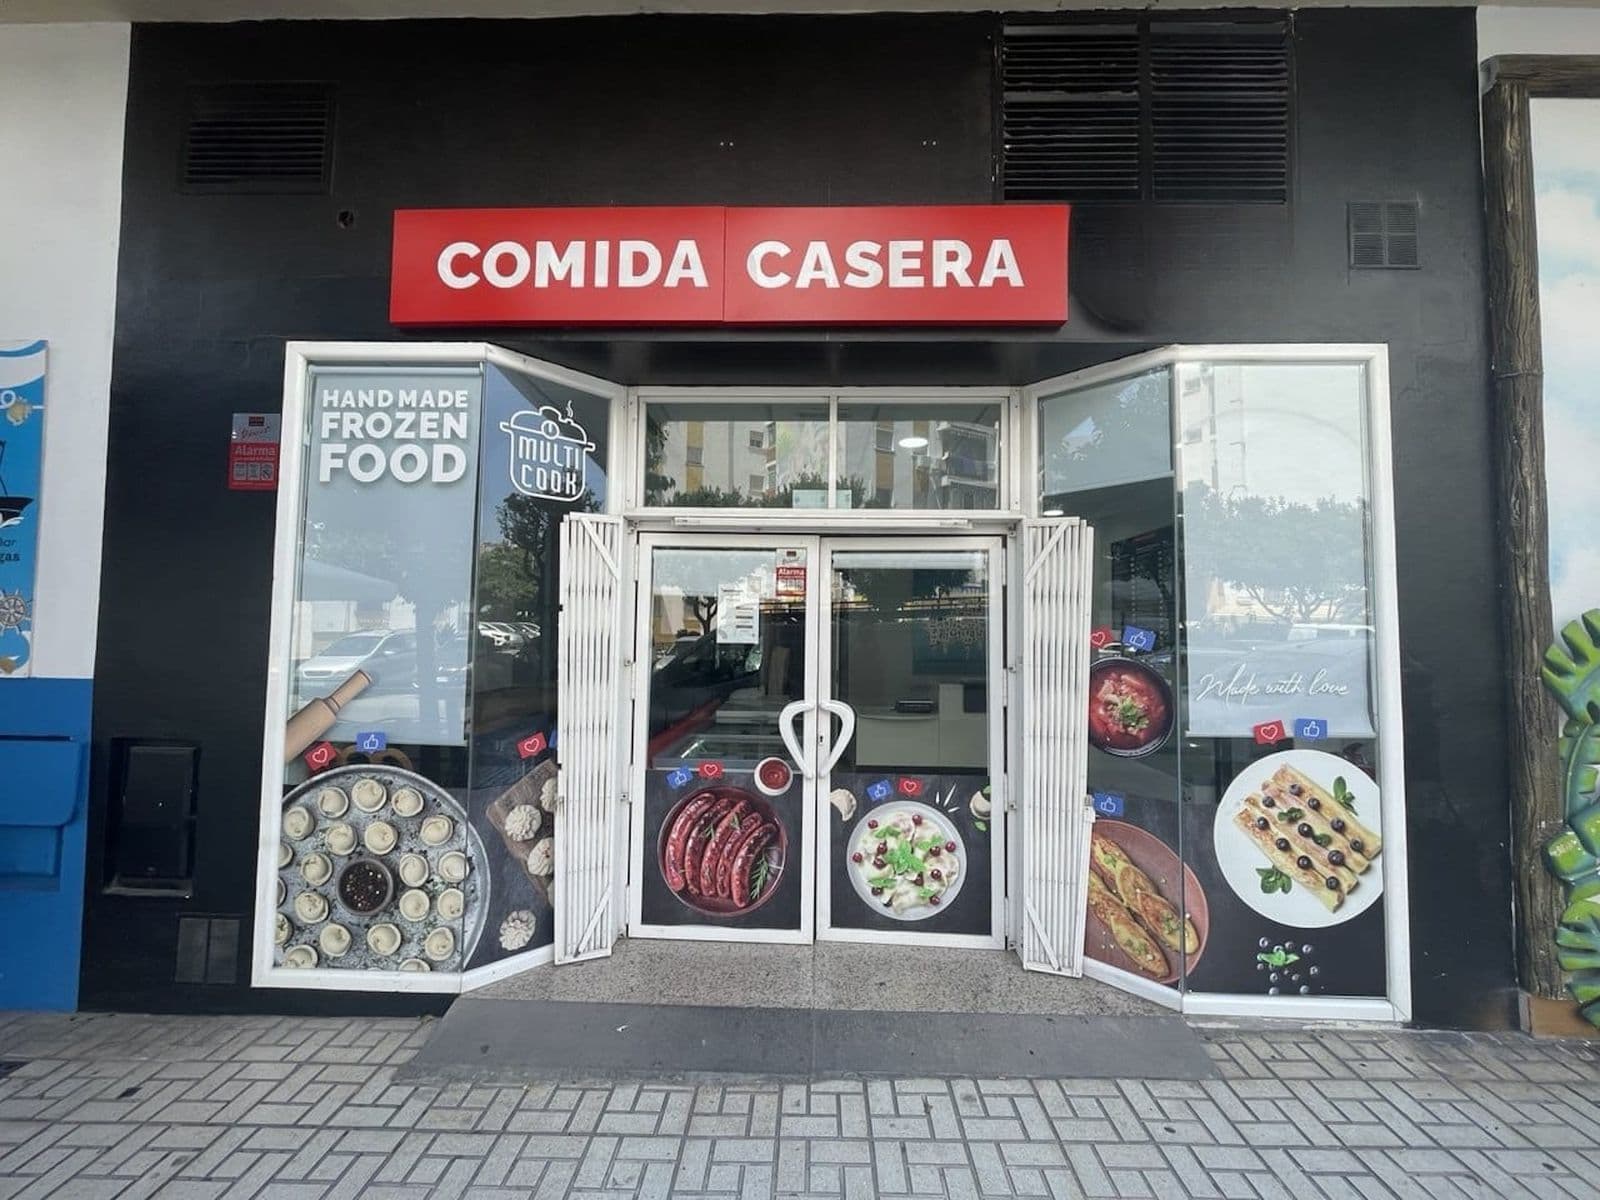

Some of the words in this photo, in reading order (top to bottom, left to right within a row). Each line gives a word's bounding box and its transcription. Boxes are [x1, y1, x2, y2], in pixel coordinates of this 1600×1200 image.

[437, 240, 709, 290] COMIDA
[746, 238, 1024, 290] CASERA
[320, 411, 468, 440] FROZEN
[235, 444, 277, 456] Alarma
[319, 443, 467, 483] FOOD
[518, 434, 580, 470] MULTI
[520, 463, 577, 496] COOK
[778, 568, 805, 576] Alarma
[1196, 663, 1260, 708] Made
[1265, 671, 1304, 697] with
